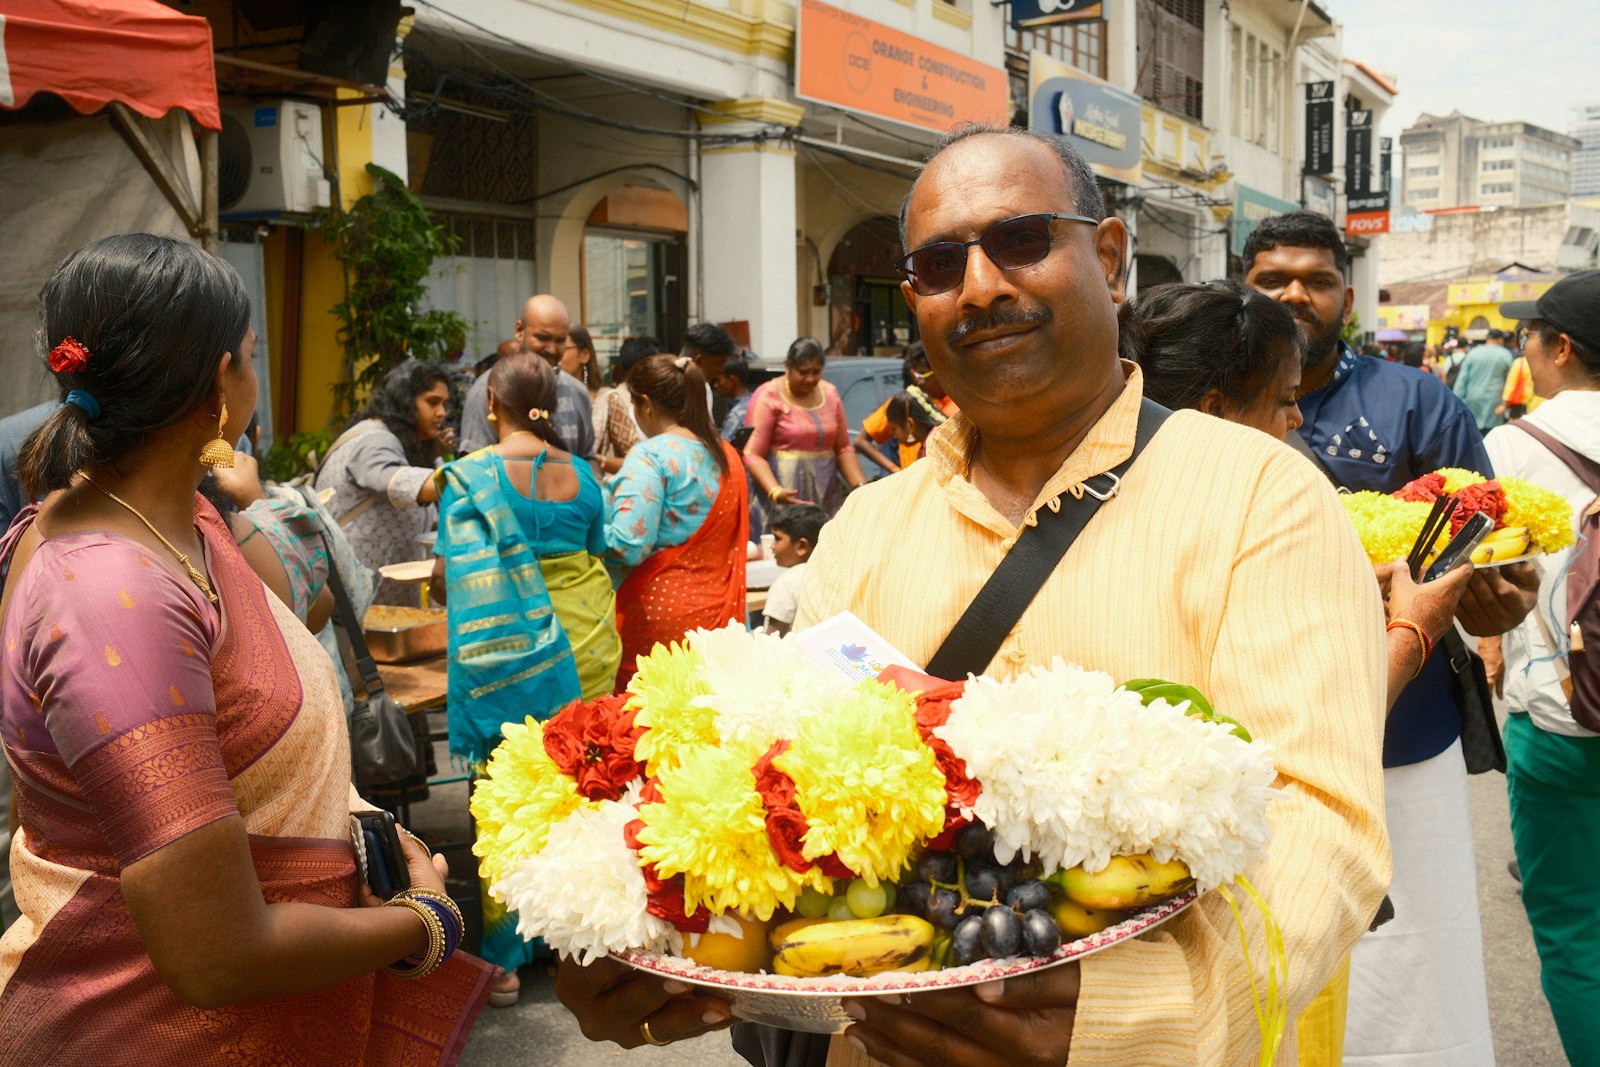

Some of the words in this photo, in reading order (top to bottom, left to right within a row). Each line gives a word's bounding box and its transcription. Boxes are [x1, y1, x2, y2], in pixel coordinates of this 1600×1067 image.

[848, 53, 870, 71] OCE
[872, 39, 915, 67] ORANGE
[918, 55, 986, 90] CONSTRUCTION
[921, 74, 929, 90] &
[893, 87, 955, 118] ENGINEERING
